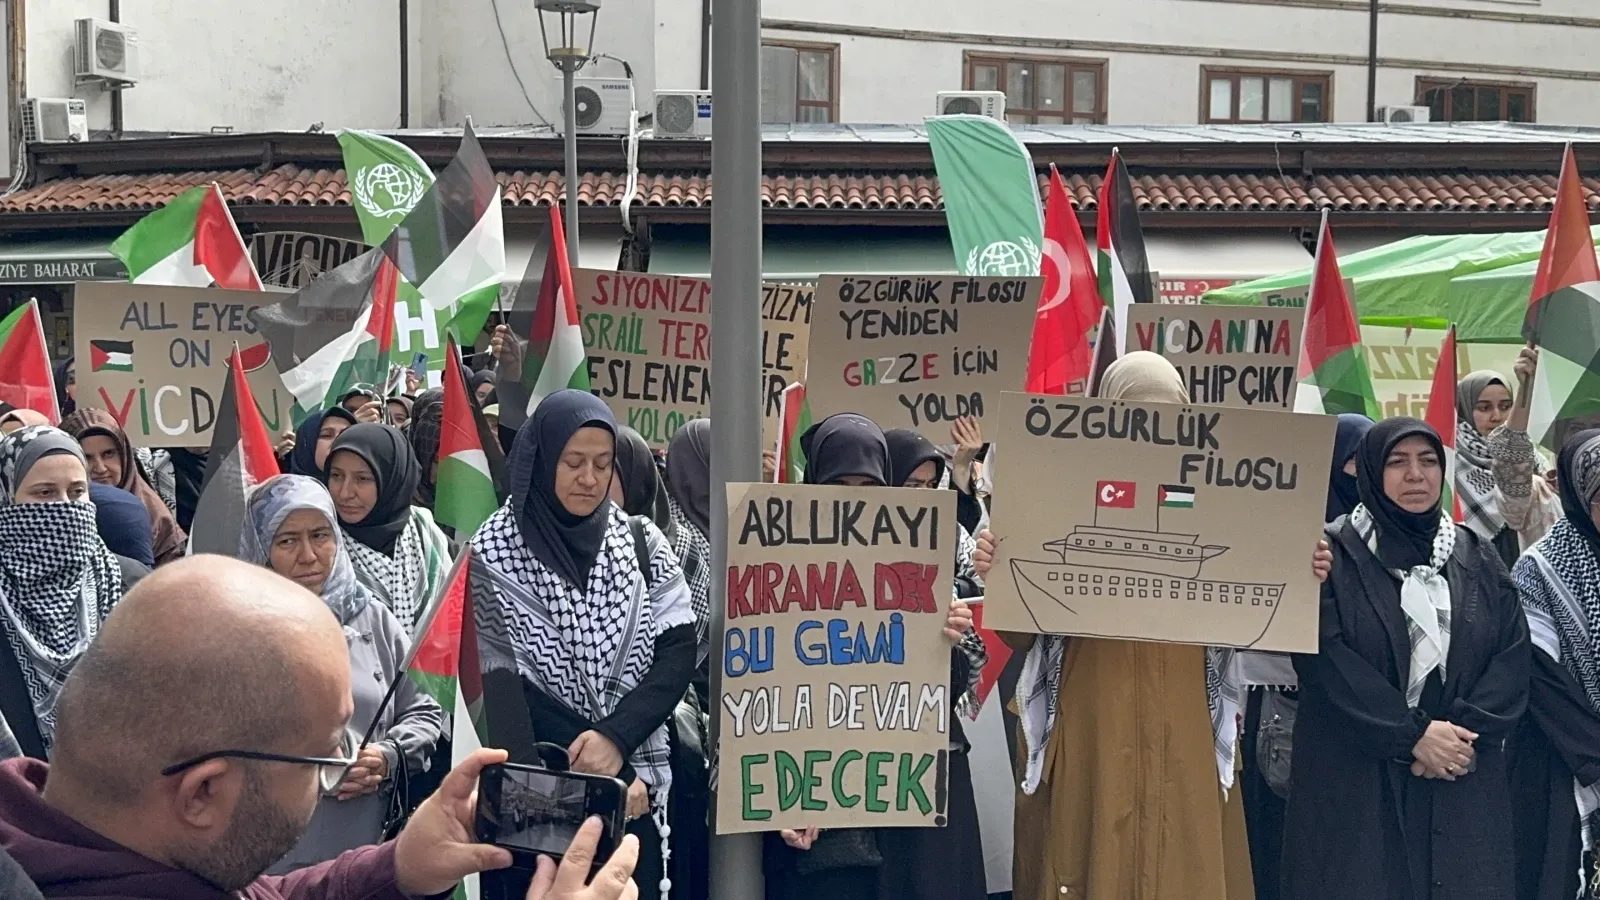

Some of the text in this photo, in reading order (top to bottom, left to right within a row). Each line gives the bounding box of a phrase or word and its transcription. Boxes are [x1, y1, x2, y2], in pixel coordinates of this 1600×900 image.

[34, 262, 97, 277] BAHARAT
[762, 285, 813, 324] ZİZM
[838, 277, 1027, 305] ÖZGÜRÜK FİLOSU
[120, 302, 262, 334] ALL EYES
[839, 305, 959, 340] YENİDEN
[1135, 316, 1291, 356] VİCDANINA
[169, 338, 211, 368] ON
[658, 319, 711, 361] TER
[762, 330, 794, 371] LE
[843, 345, 998, 387] GAZZE İÇİN
[98, 378, 280, 436] VİCDN
[586, 356, 787, 418] ESLENEN İR
[1175, 365, 1295, 408] AHİP ÇIK!
[628, 406, 702, 443] KOLO
[898, 392, 984, 427] YOLDA
[1025, 398, 1221, 450] ÖZGÜRLÜK
[1180, 451, 1298, 490] FİLOSU
[738, 497, 938, 550] ABLUKAYI
[727, 559, 939, 620] KIRANA DEK
[724, 612, 905, 678] BU GEMİ
[723, 681, 946, 737] YOLA DEVAM
[741, 749, 948, 827] EDECEK!
